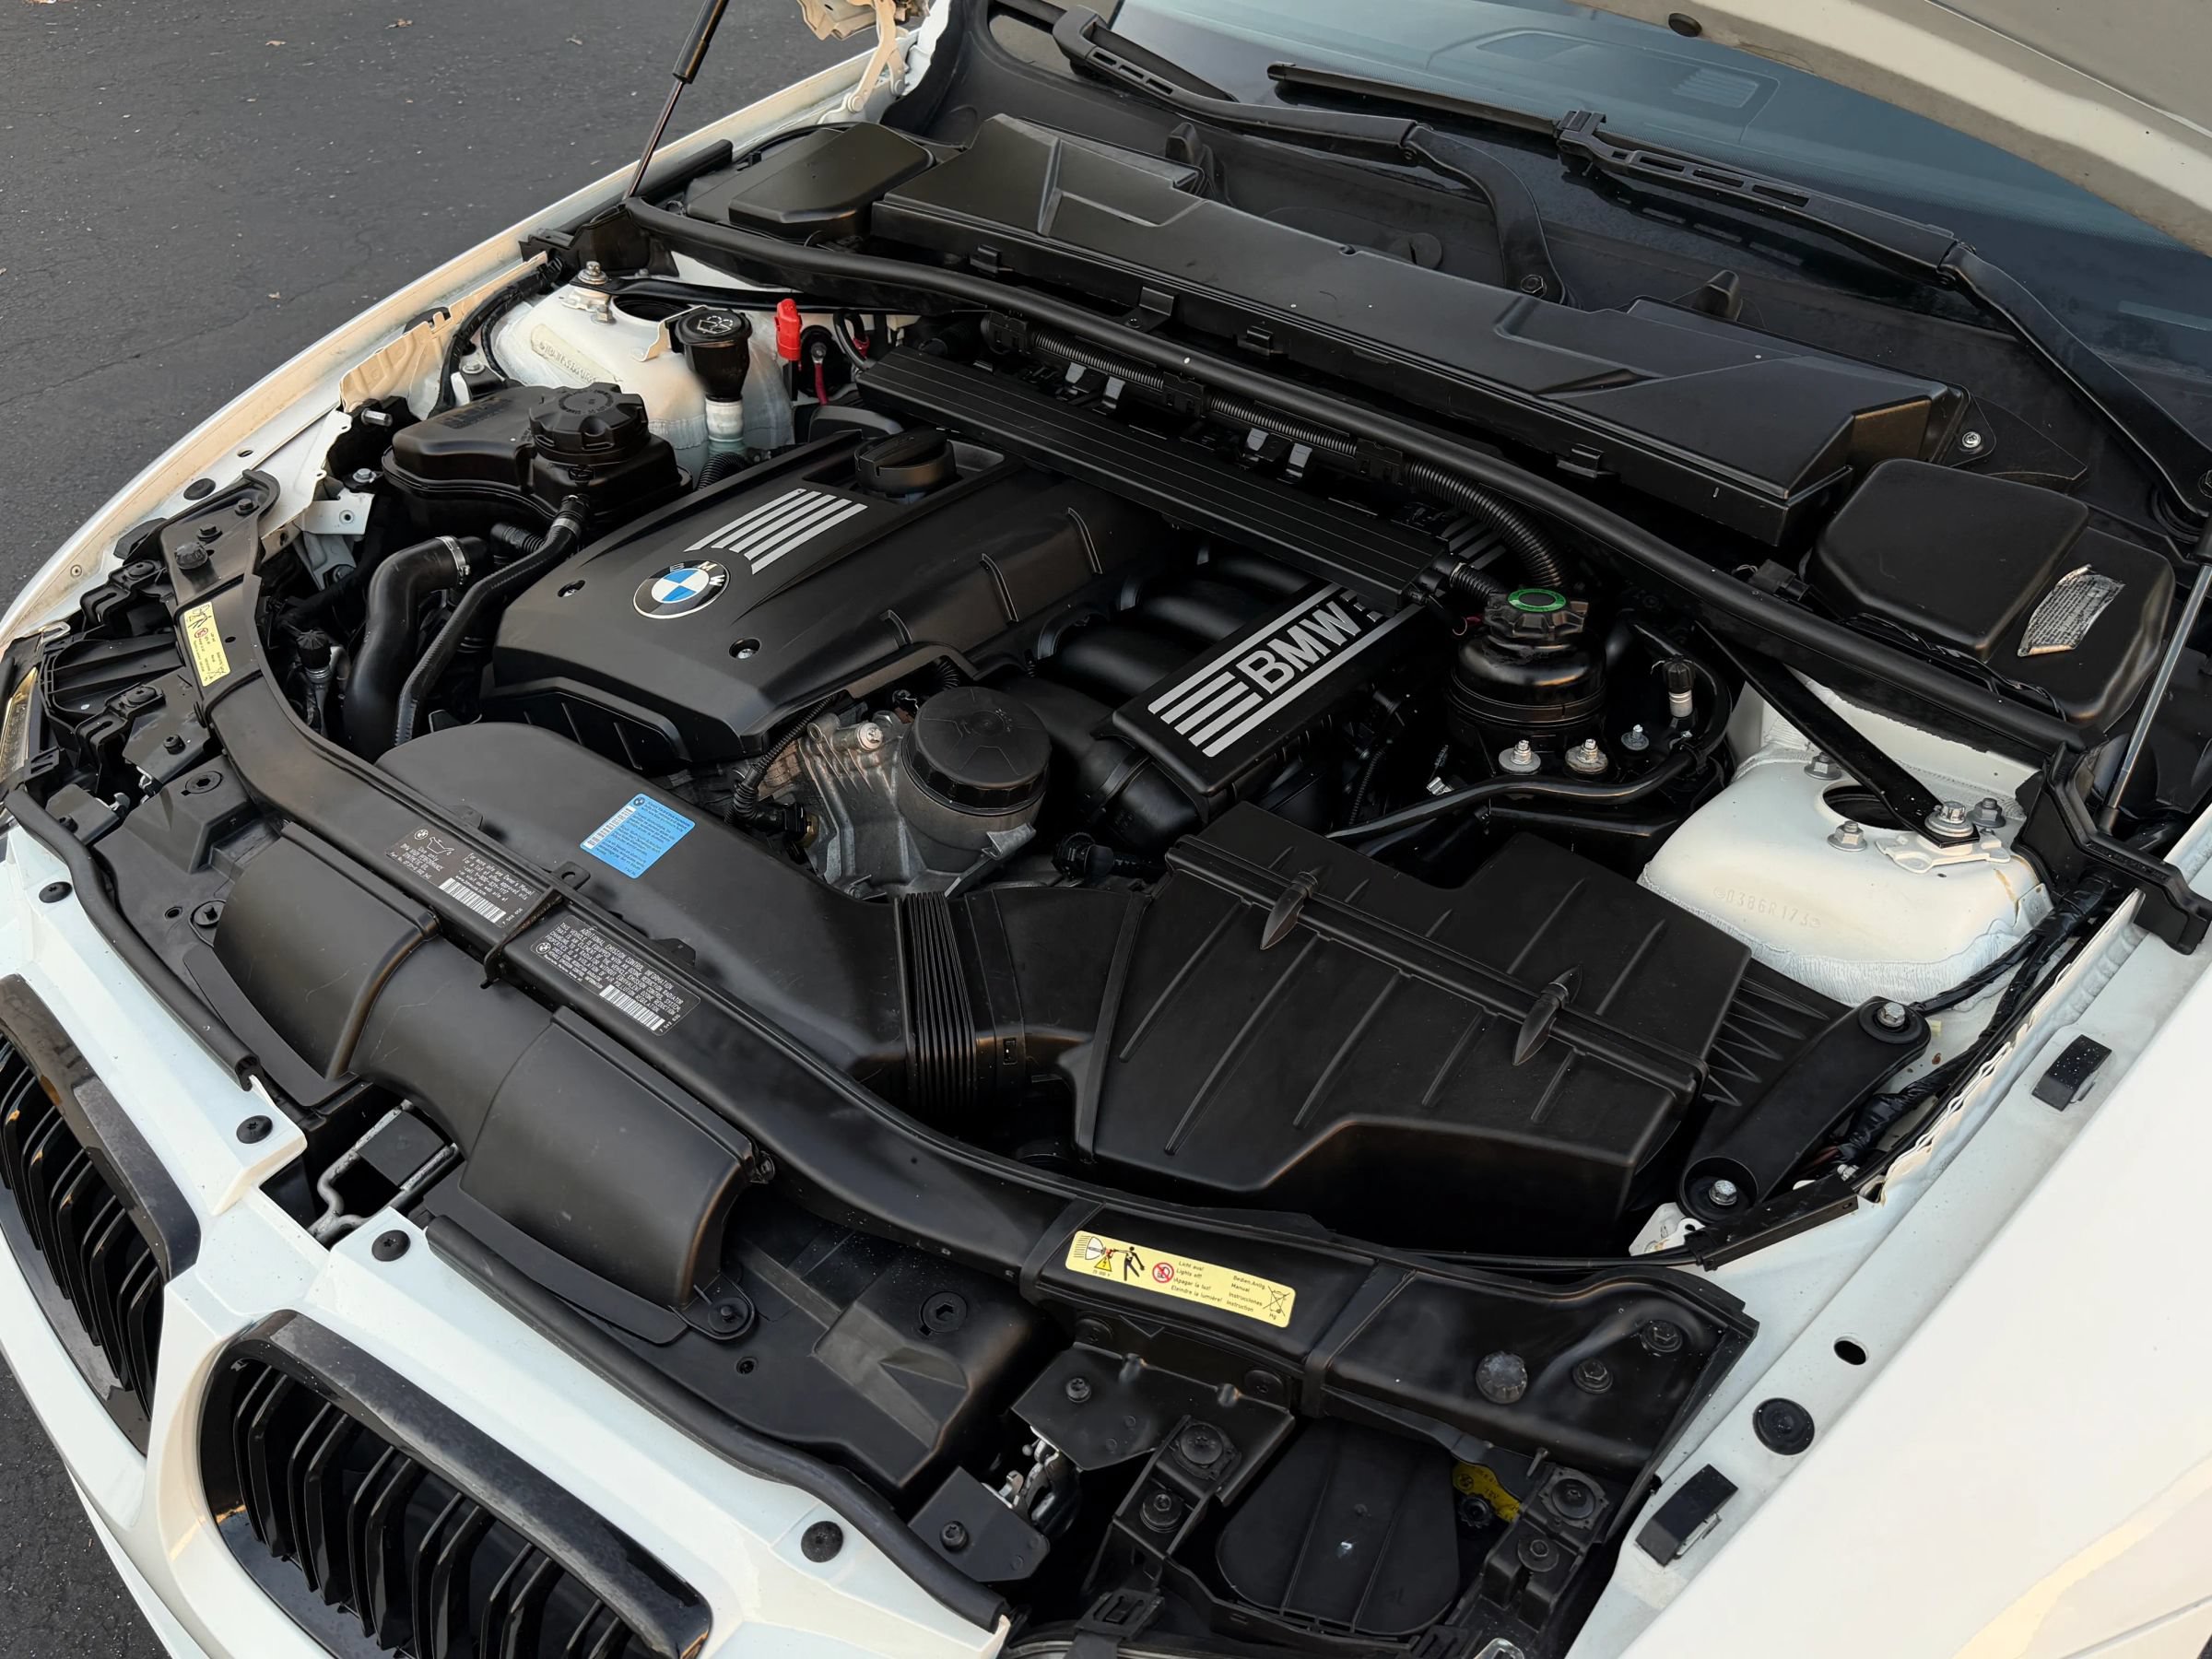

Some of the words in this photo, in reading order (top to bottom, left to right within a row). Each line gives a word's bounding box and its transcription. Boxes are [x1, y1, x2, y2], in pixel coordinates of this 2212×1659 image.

[1236, 600, 1362, 695] BMW
[474, 865, 484, 873] list
[488, 874, 501, 884] other
[500, 880, 521, 895] approved
[518, 891, 529, 900] oils
[475, 858, 487, 867] more
[485, 865, 496, 873] info
[518, 884, 535, 896] Manual
[544, 935, 569, 952] PROPERTIES
[577, 957, 600, 972] VIOLATION
[614, 981, 637, 996] POLLUTION
[549, 931, 570, 946] CHANGING
[579, 950, 600, 965] RADIATOR
[598, 963, 618, 977] WITHOUT
[616, 975, 641, 993] EQUIVALENT
[640, 991, 655, 1001] OZONE
[653, 999, 677, 1016] REDUCTION
[554, 927, 567, 935] THAT
[577, 942, 596, 956] ELEMENT
[610, 964, 629, 977] VEHICLE
[627, 975, 647, 989] EMISSION
[646, 987, 665, 1000] CONTROL
[559, 923, 571, 931] THIS
[570, 929, 587, 942] VEHICLE
[592, 944, 612, 958] EQUIPPED
[610, 956, 623, 965] WITH
[628, 968, 641, 978] OZONE
[641, 976, 664, 992] REDUCTION
[662, 990, 684, 1006] RADIATOR
[580, 928, 606, 947] ADDITIONAL
[605, 944, 627, 959] EMISSION
[625, 958, 645, 971] CONTROL
[644, 970, 674, 991] INFORMATION
[1176, 1268, 1193, 1277] Lights
[1179, 1261, 1193, 1269] Licht
[1231, 1284, 1250, 1292] Manual
